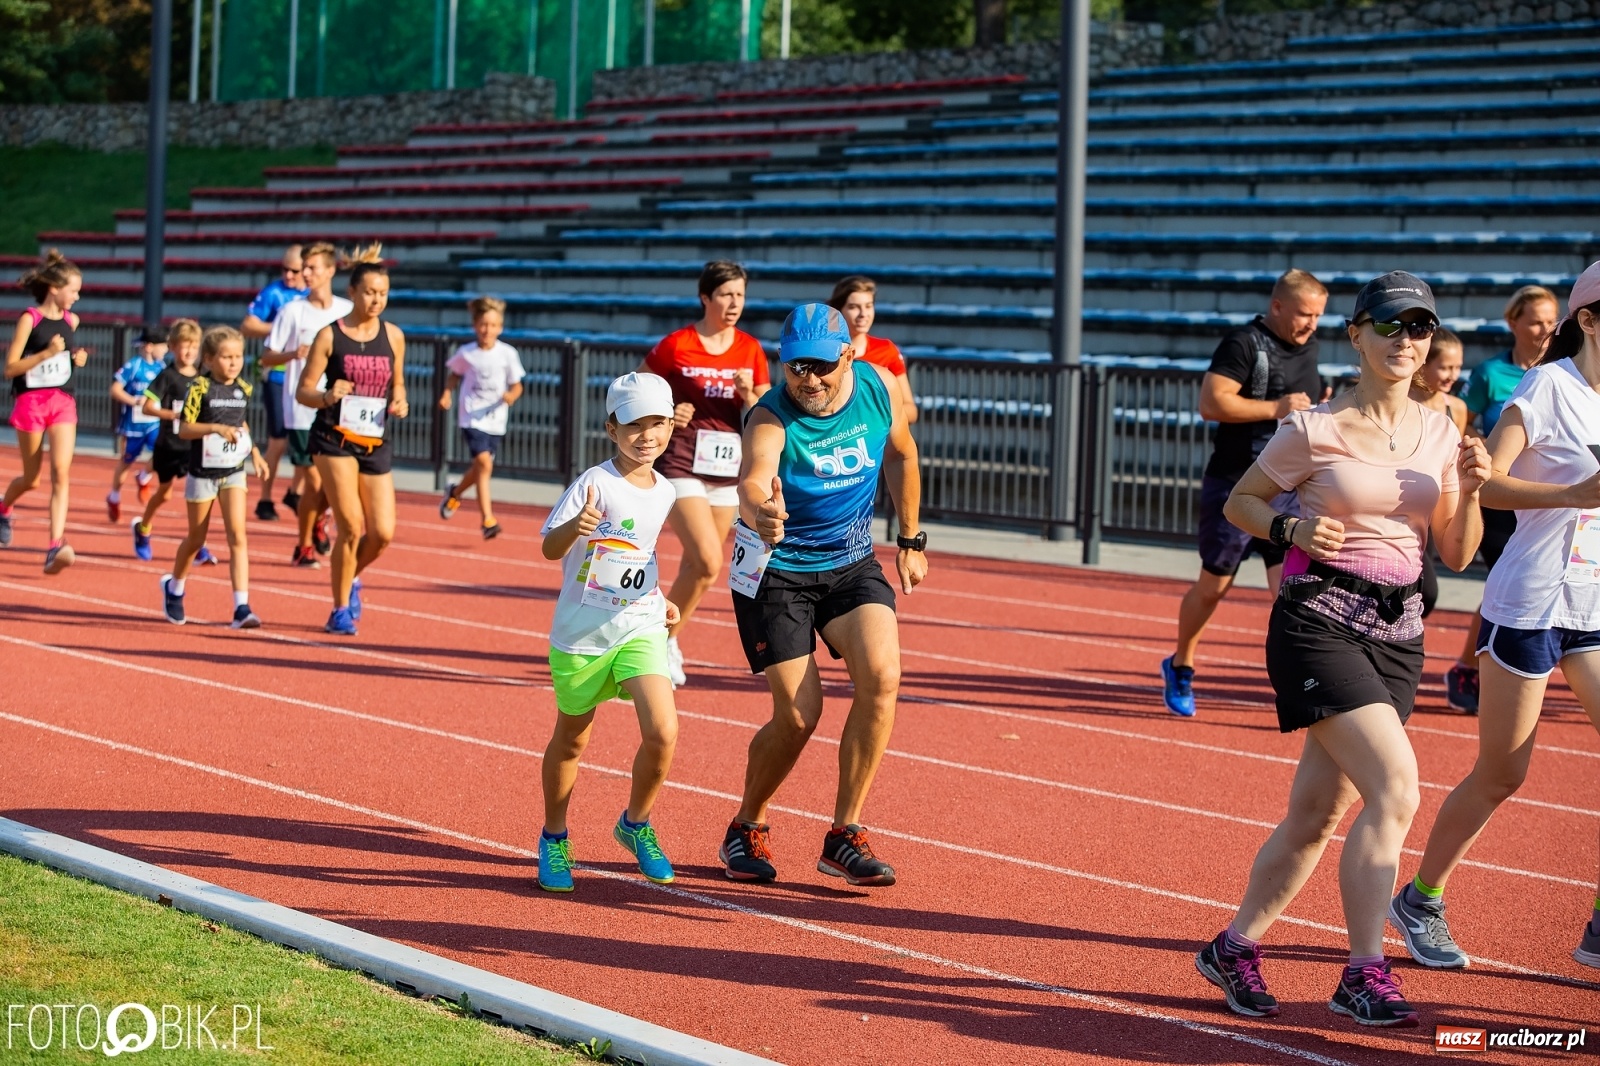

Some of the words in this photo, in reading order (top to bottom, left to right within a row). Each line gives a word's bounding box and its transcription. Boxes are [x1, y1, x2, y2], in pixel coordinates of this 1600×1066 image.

[343, 354, 390, 371] SWEAT
[344, 370, 392, 386] TODAY
[360, 409, 374, 423] 81
[222, 441, 237, 453] 80
[714, 445, 734, 460] 128
[823, 475, 866, 490] RACIBÓRZ
[620, 567, 646, 590] 60
